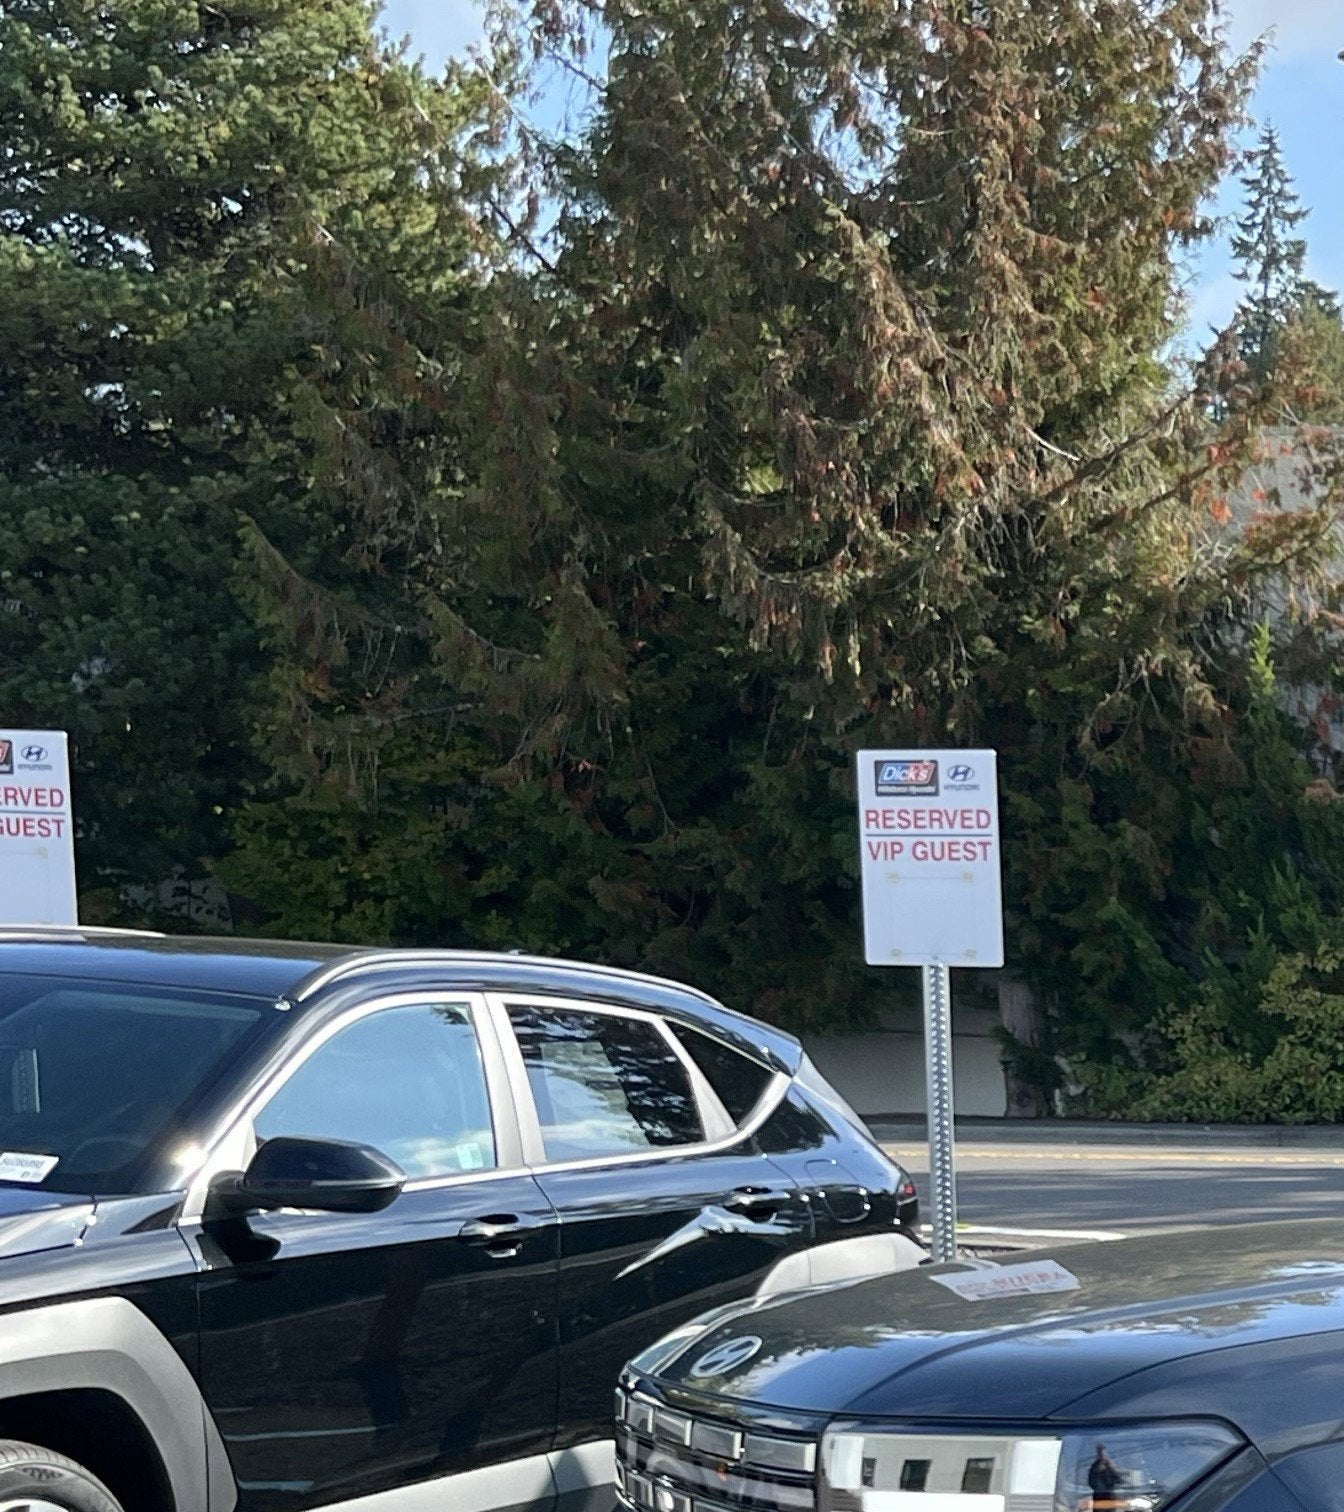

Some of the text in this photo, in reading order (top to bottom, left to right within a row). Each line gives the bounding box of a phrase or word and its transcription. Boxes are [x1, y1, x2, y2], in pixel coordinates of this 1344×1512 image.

[0, 786, 64, 808] RVED
[865, 808, 991, 830] RESERVED
[867, 840, 992, 862] VIP GUEST
